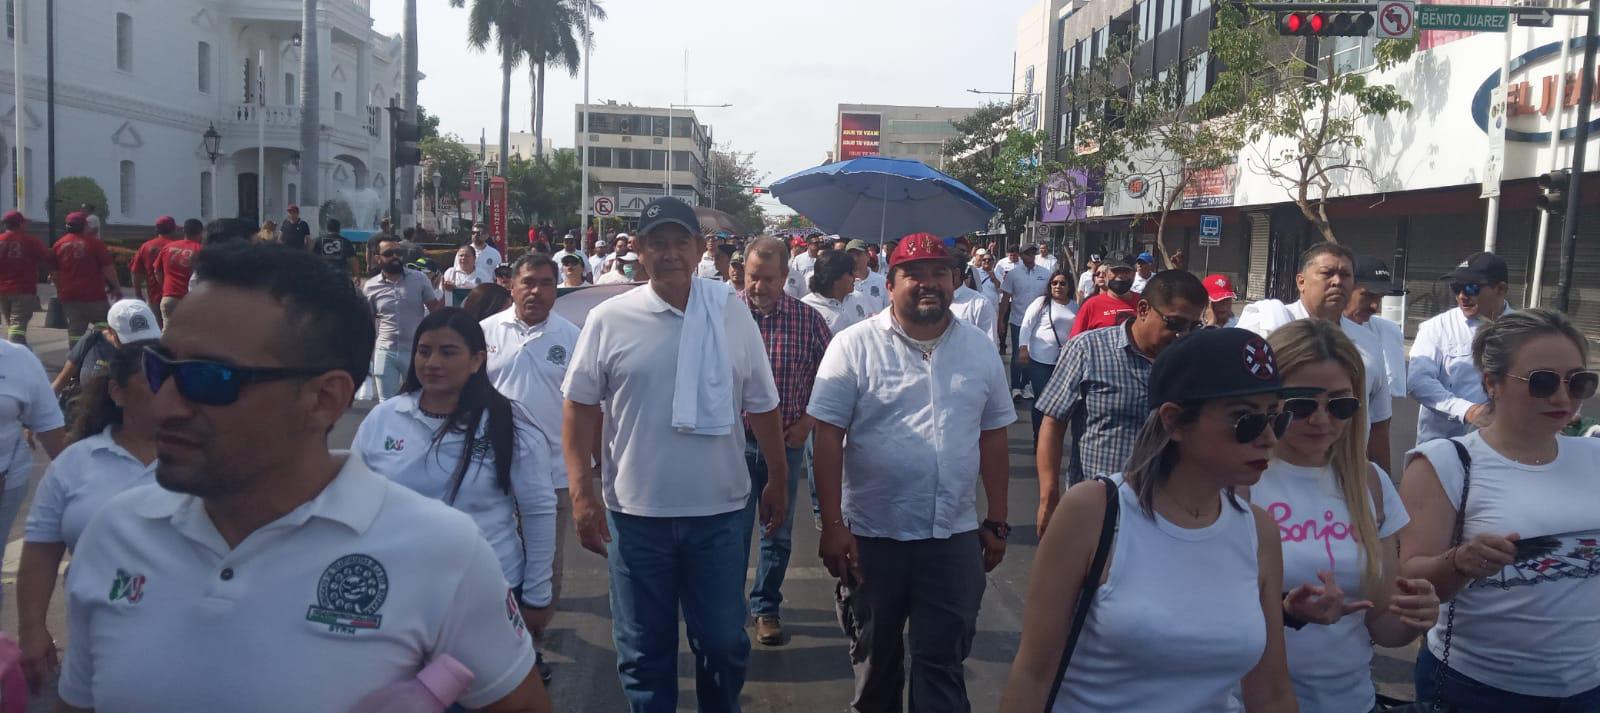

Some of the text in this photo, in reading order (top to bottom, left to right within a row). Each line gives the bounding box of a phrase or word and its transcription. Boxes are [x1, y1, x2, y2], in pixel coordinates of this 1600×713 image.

[1421, 12, 1506, 27] BENITO JUAREZ
[323, 240, 341, 255] G3
